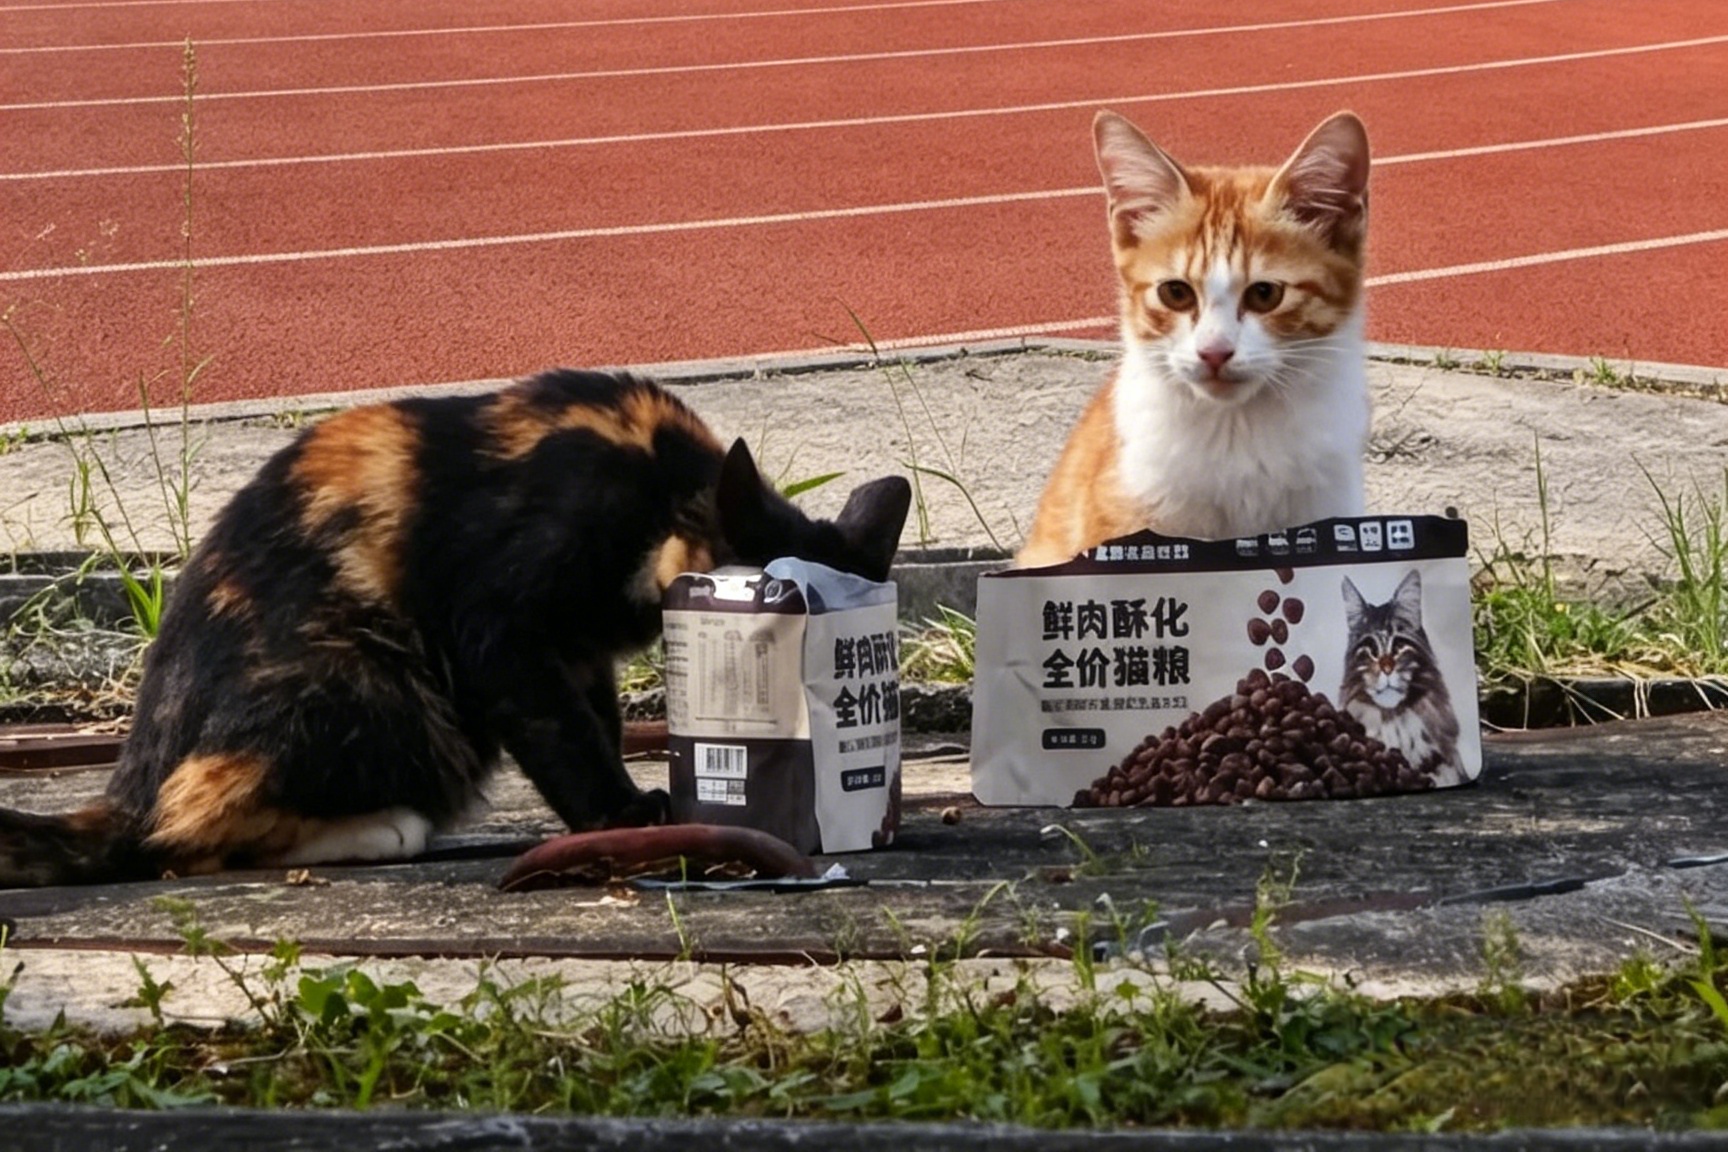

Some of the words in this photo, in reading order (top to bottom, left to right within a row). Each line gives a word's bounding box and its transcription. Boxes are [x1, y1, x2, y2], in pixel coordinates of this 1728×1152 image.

[1042, 597, 1189, 641] 鲜肉酥化
[1042, 645, 1191, 689] 全价猫粮
